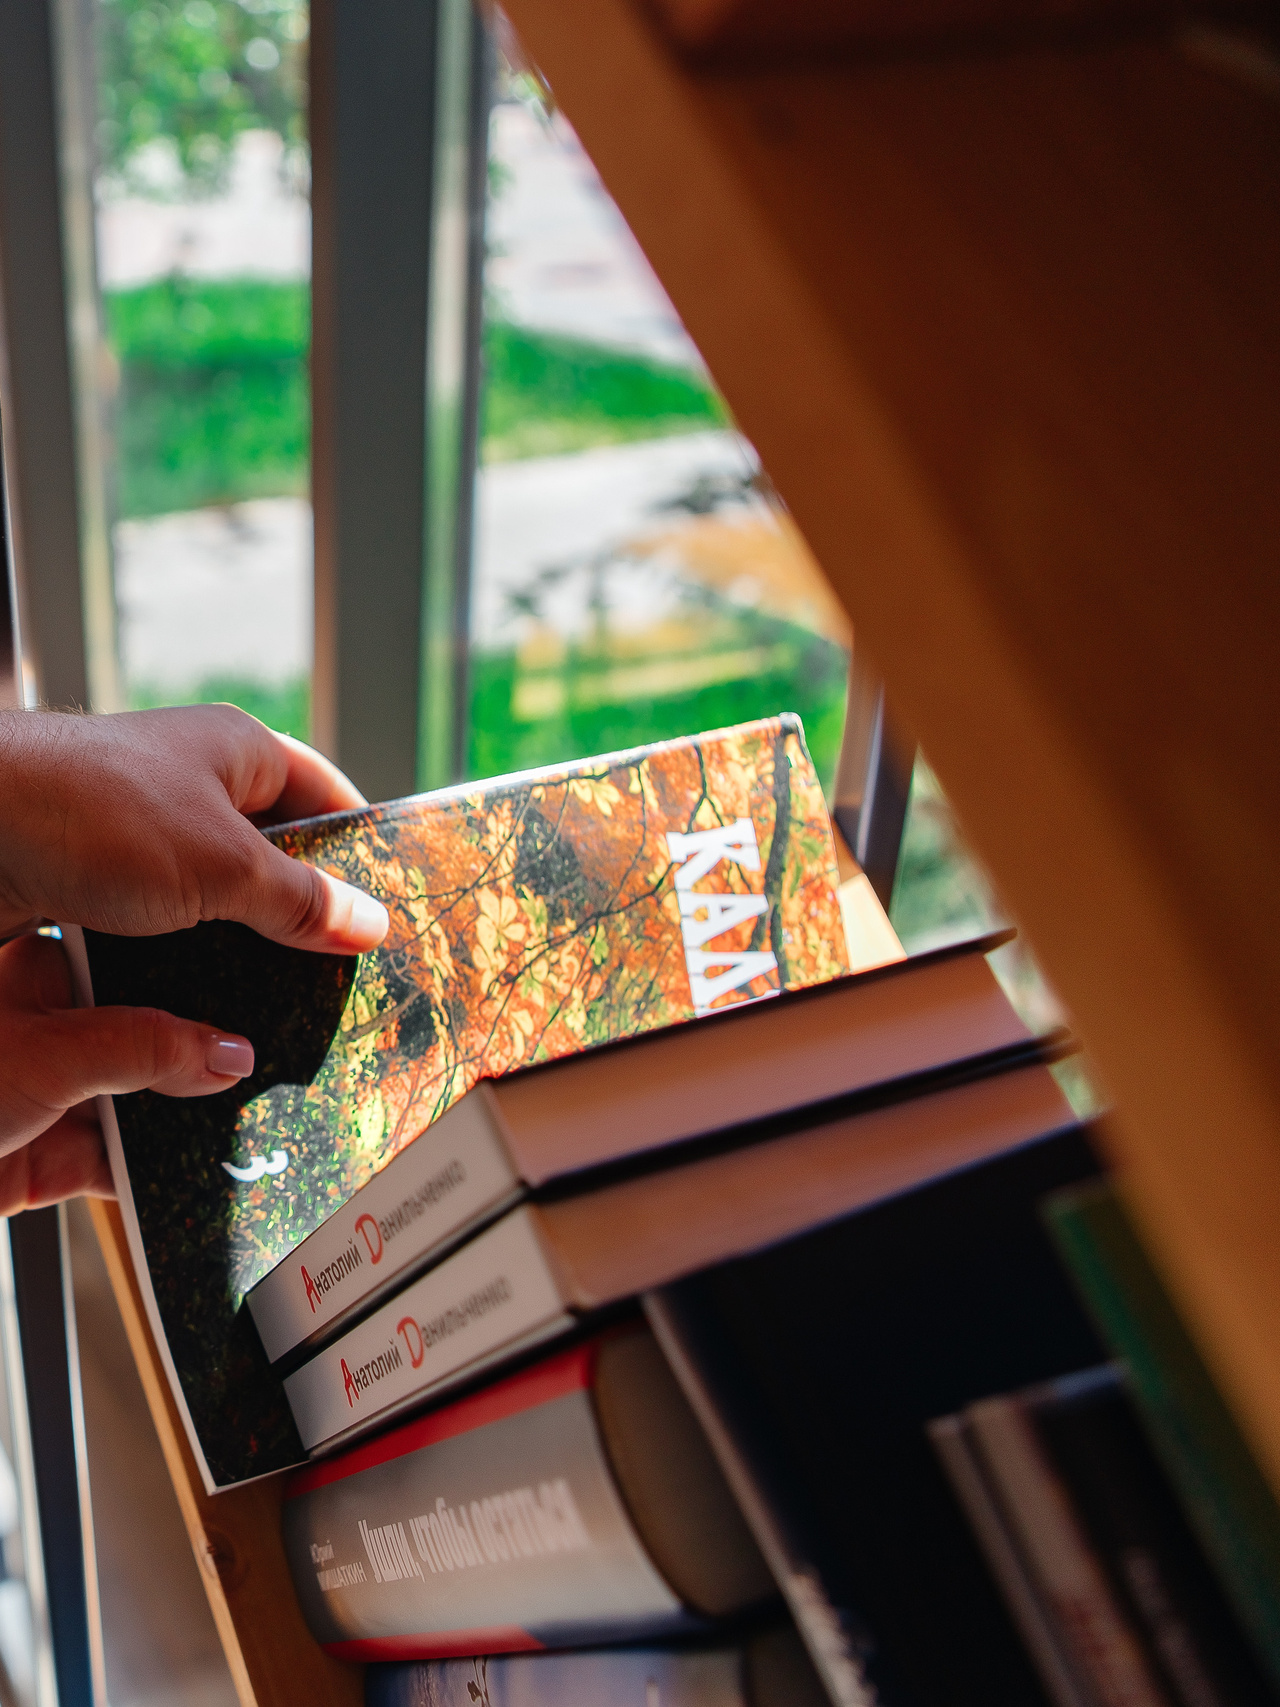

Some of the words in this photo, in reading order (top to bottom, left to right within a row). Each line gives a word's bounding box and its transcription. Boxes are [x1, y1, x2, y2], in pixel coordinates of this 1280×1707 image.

[666, 817, 781, 1018] КАЛ
[300, 1238, 364, 1313] Анатолий
[354, 1158, 468, 1265] Данильченко
[339, 1339, 404, 1408] Анатолий
